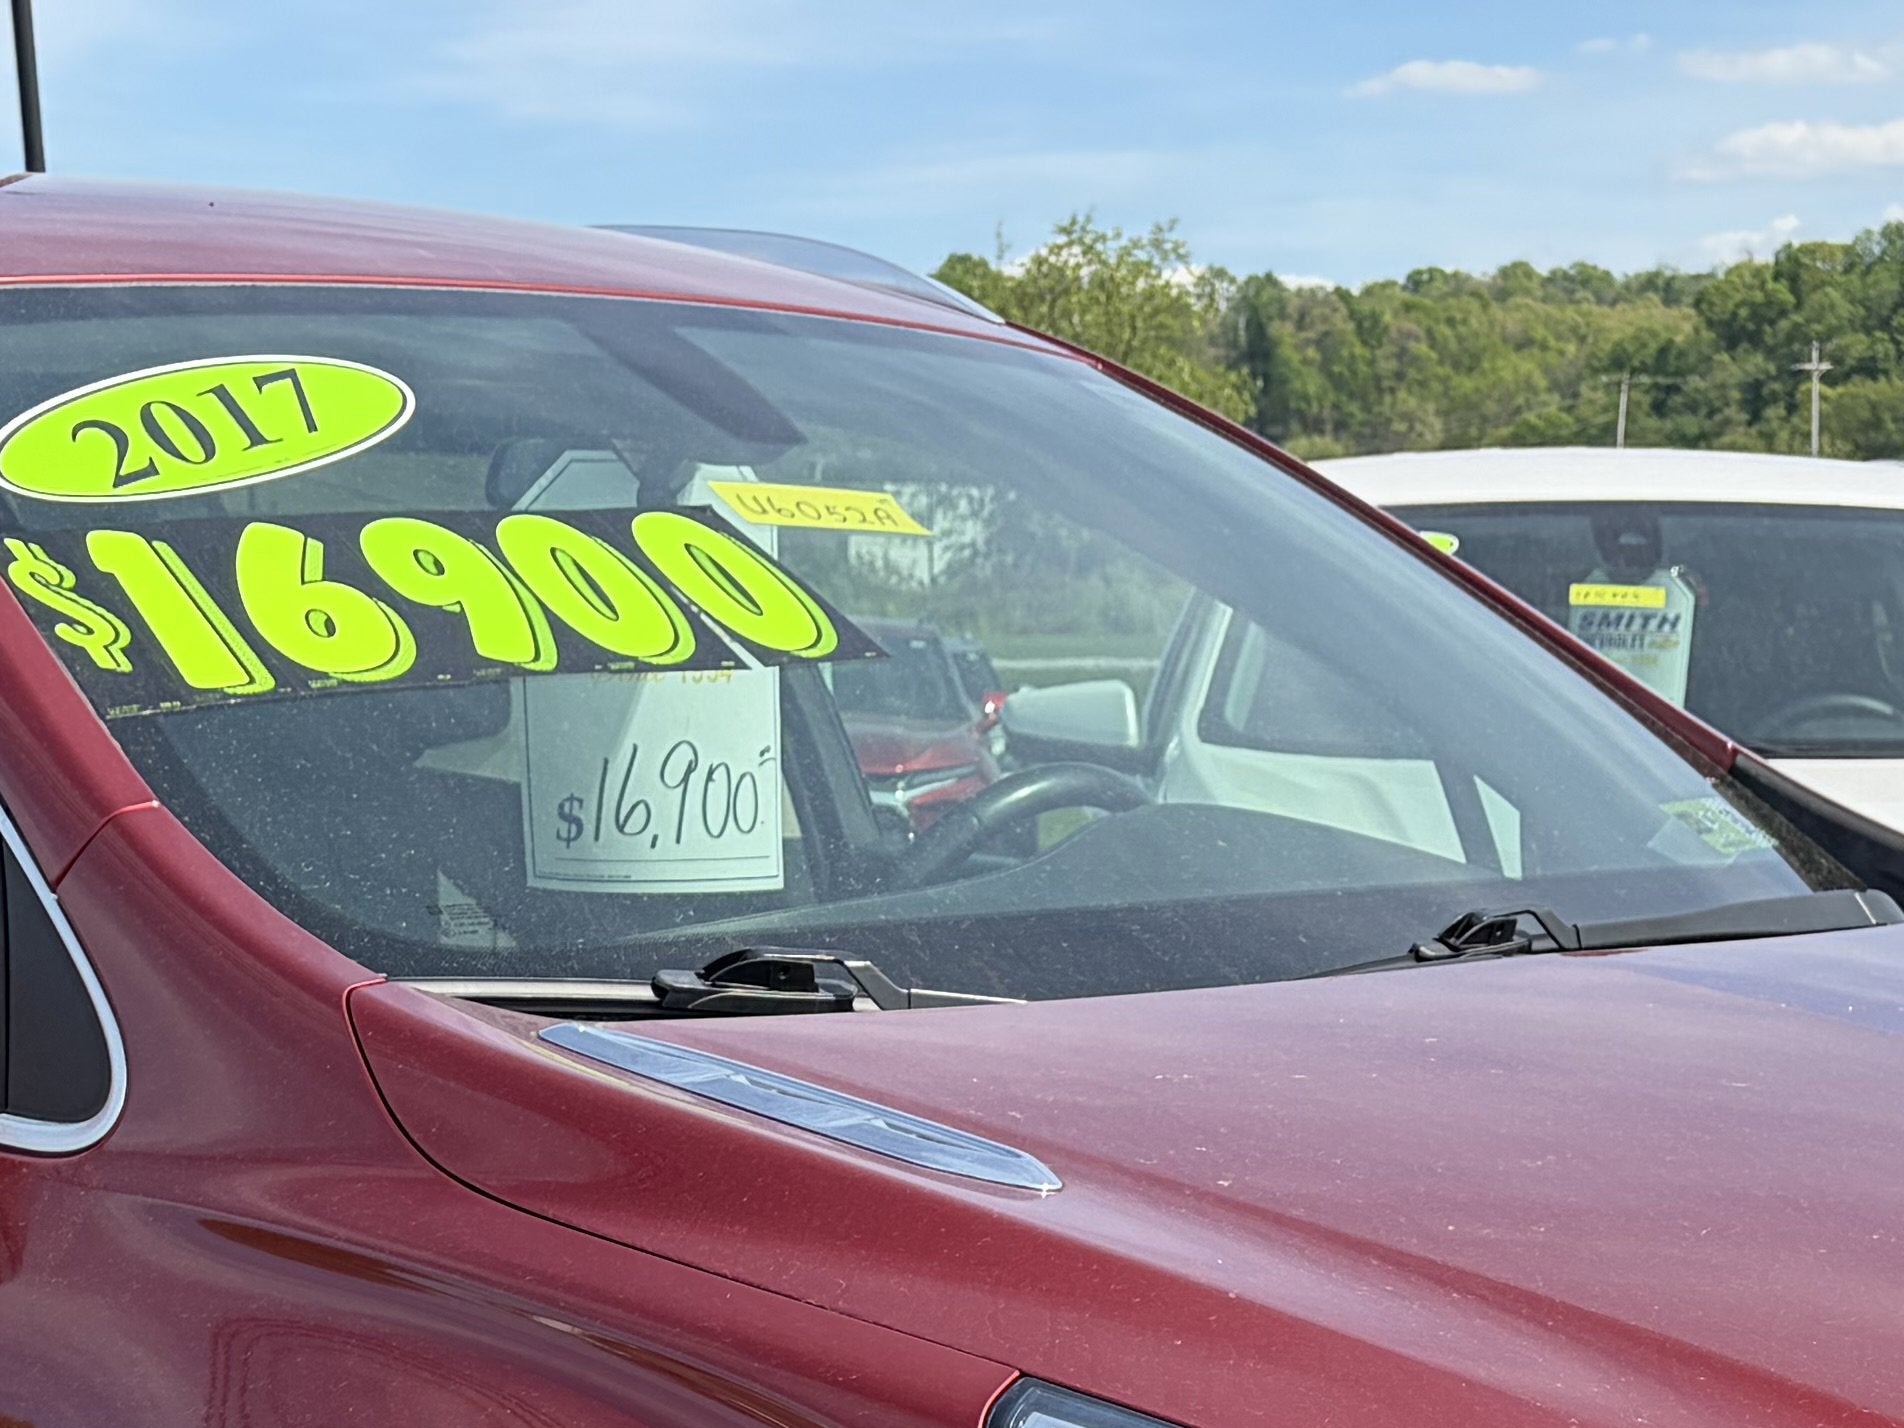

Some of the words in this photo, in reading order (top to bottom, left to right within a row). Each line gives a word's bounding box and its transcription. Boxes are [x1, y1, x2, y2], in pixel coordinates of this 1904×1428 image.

[71, 368, 323, 488] 2017
[3, 511, 839, 695] $16900
[1578, 611, 1681, 632] SMITH
